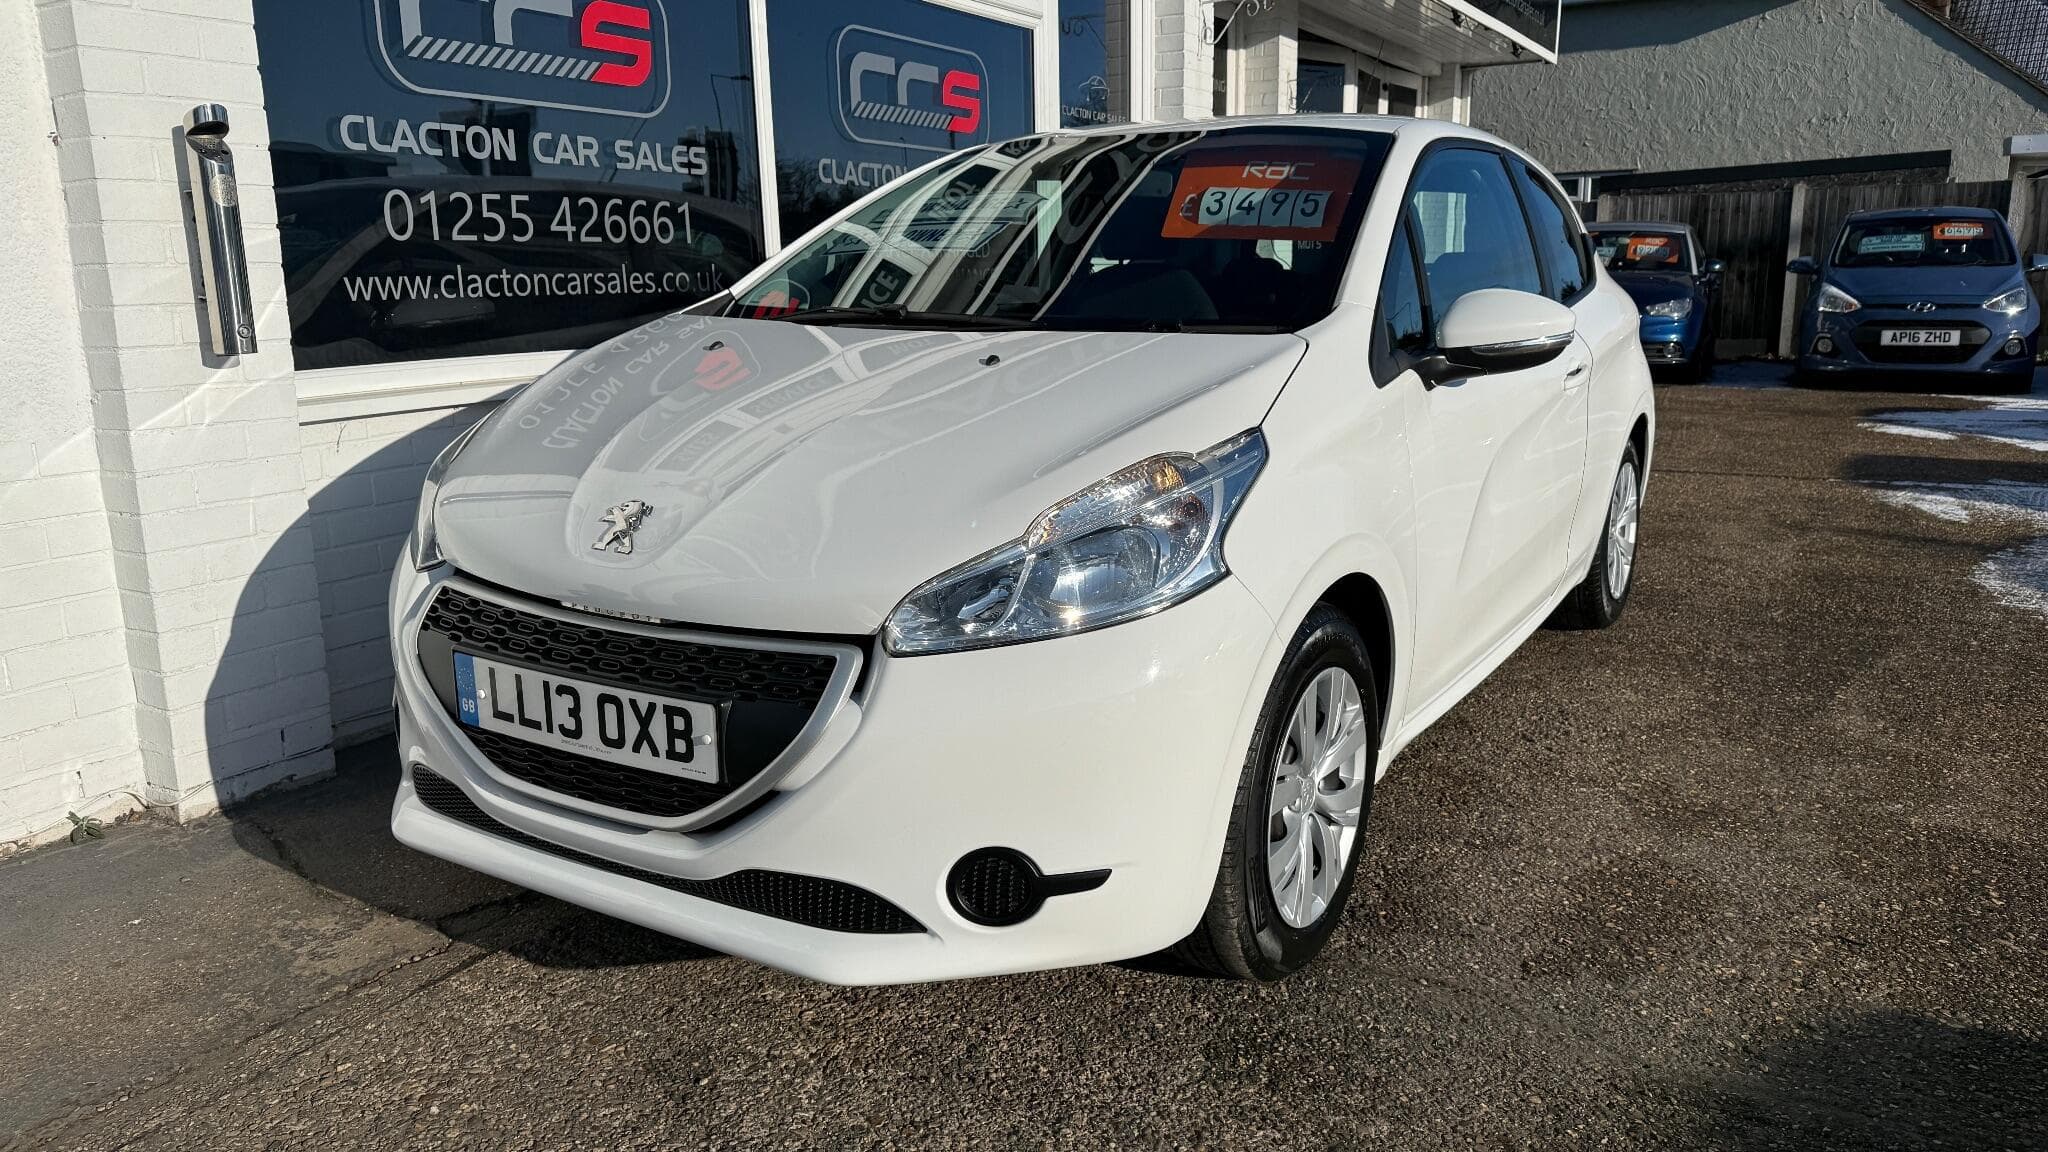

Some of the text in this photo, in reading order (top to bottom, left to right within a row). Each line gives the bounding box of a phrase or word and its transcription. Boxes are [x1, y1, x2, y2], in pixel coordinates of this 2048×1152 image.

[1062, 105, 1091, 120] CLACTON
[1092, 111, 1106, 121] CAR
[339, 114, 708, 175] CLACTON CAR SALES
[383, 188, 692, 244] 01255 426661
[343, 264, 723, 302] www.clactoncarsales.co.uk
[1890, 331, 1952, 343] AP16 ZHD
[462, 698, 475, 713] GB
[488, 666, 695, 764] LL13 OXB
